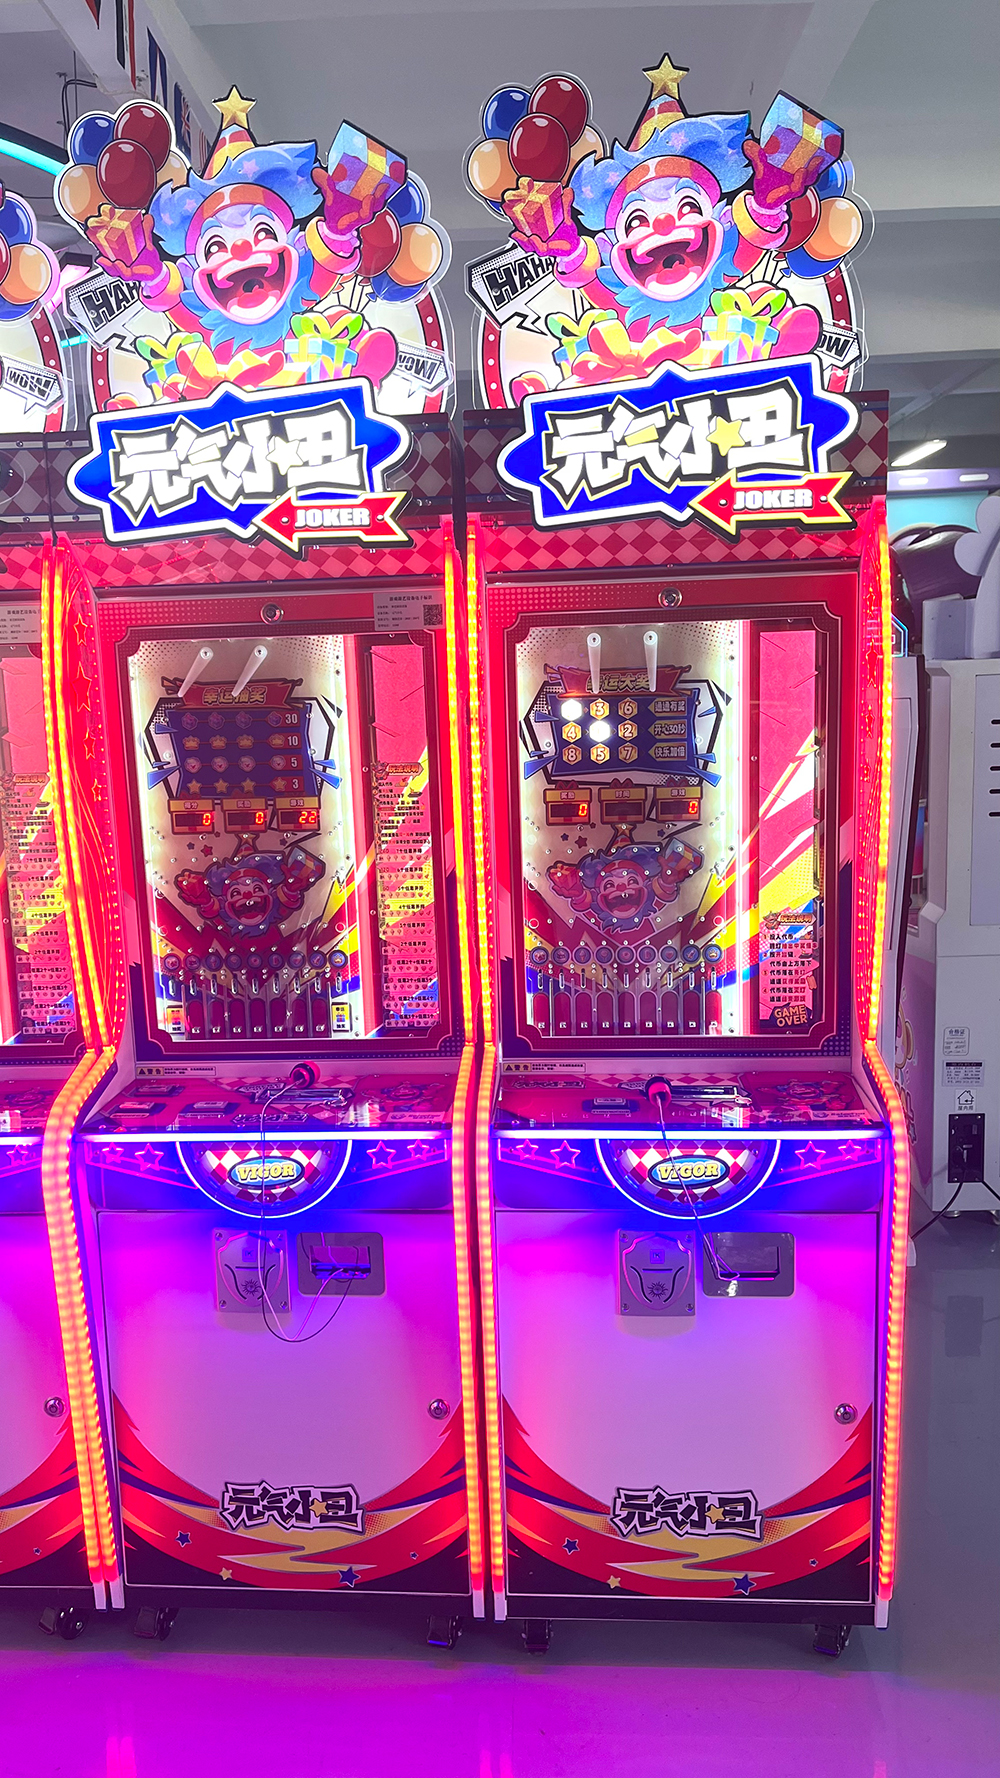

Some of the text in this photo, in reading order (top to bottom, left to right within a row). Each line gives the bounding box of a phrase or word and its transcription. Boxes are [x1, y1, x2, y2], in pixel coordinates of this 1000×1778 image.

[820, 333, 851, 358] OW
[548, 383, 808, 500] 元气小丑
[113, 404, 366, 510] 元气小丑
[733, 488, 813, 511] JOKER
[294, 506, 371, 529] JOKER
[203, 687, 266, 704] 幸运抽奖
[595, 704, 605, 716] 3
[623, 703, 633, 715] 6
[285, 713, 298, 724] 30
[567, 726, 577, 739] 4
[623, 725, 633, 737] 2
[287, 736, 299, 746] 10
[567, 748, 577, 761] 8
[595, 747, 605, 761] 5
[623, 747, 633, 760] 7
[291, 757, 298, 768] 5
[292, 779, 299, 789] 3
[578, 803, 588, 816] 0
[688, 801, 698, 814] 0
[202, 812, 211, 826] 0
[255, 811, 264, 824] 0
[299, 811, 317, 824] 22
[774, 1005, 806, 1018] GAME
[777, 1015, 808, 1027] OVER
[238, 1164, 294, 1181] VIGOR
[658, 1164, 720, 1180] VIGOR
[226, 1485, 359, 1527] 元气小丑
[616, 1490, 757, 1534] 元气小丑
